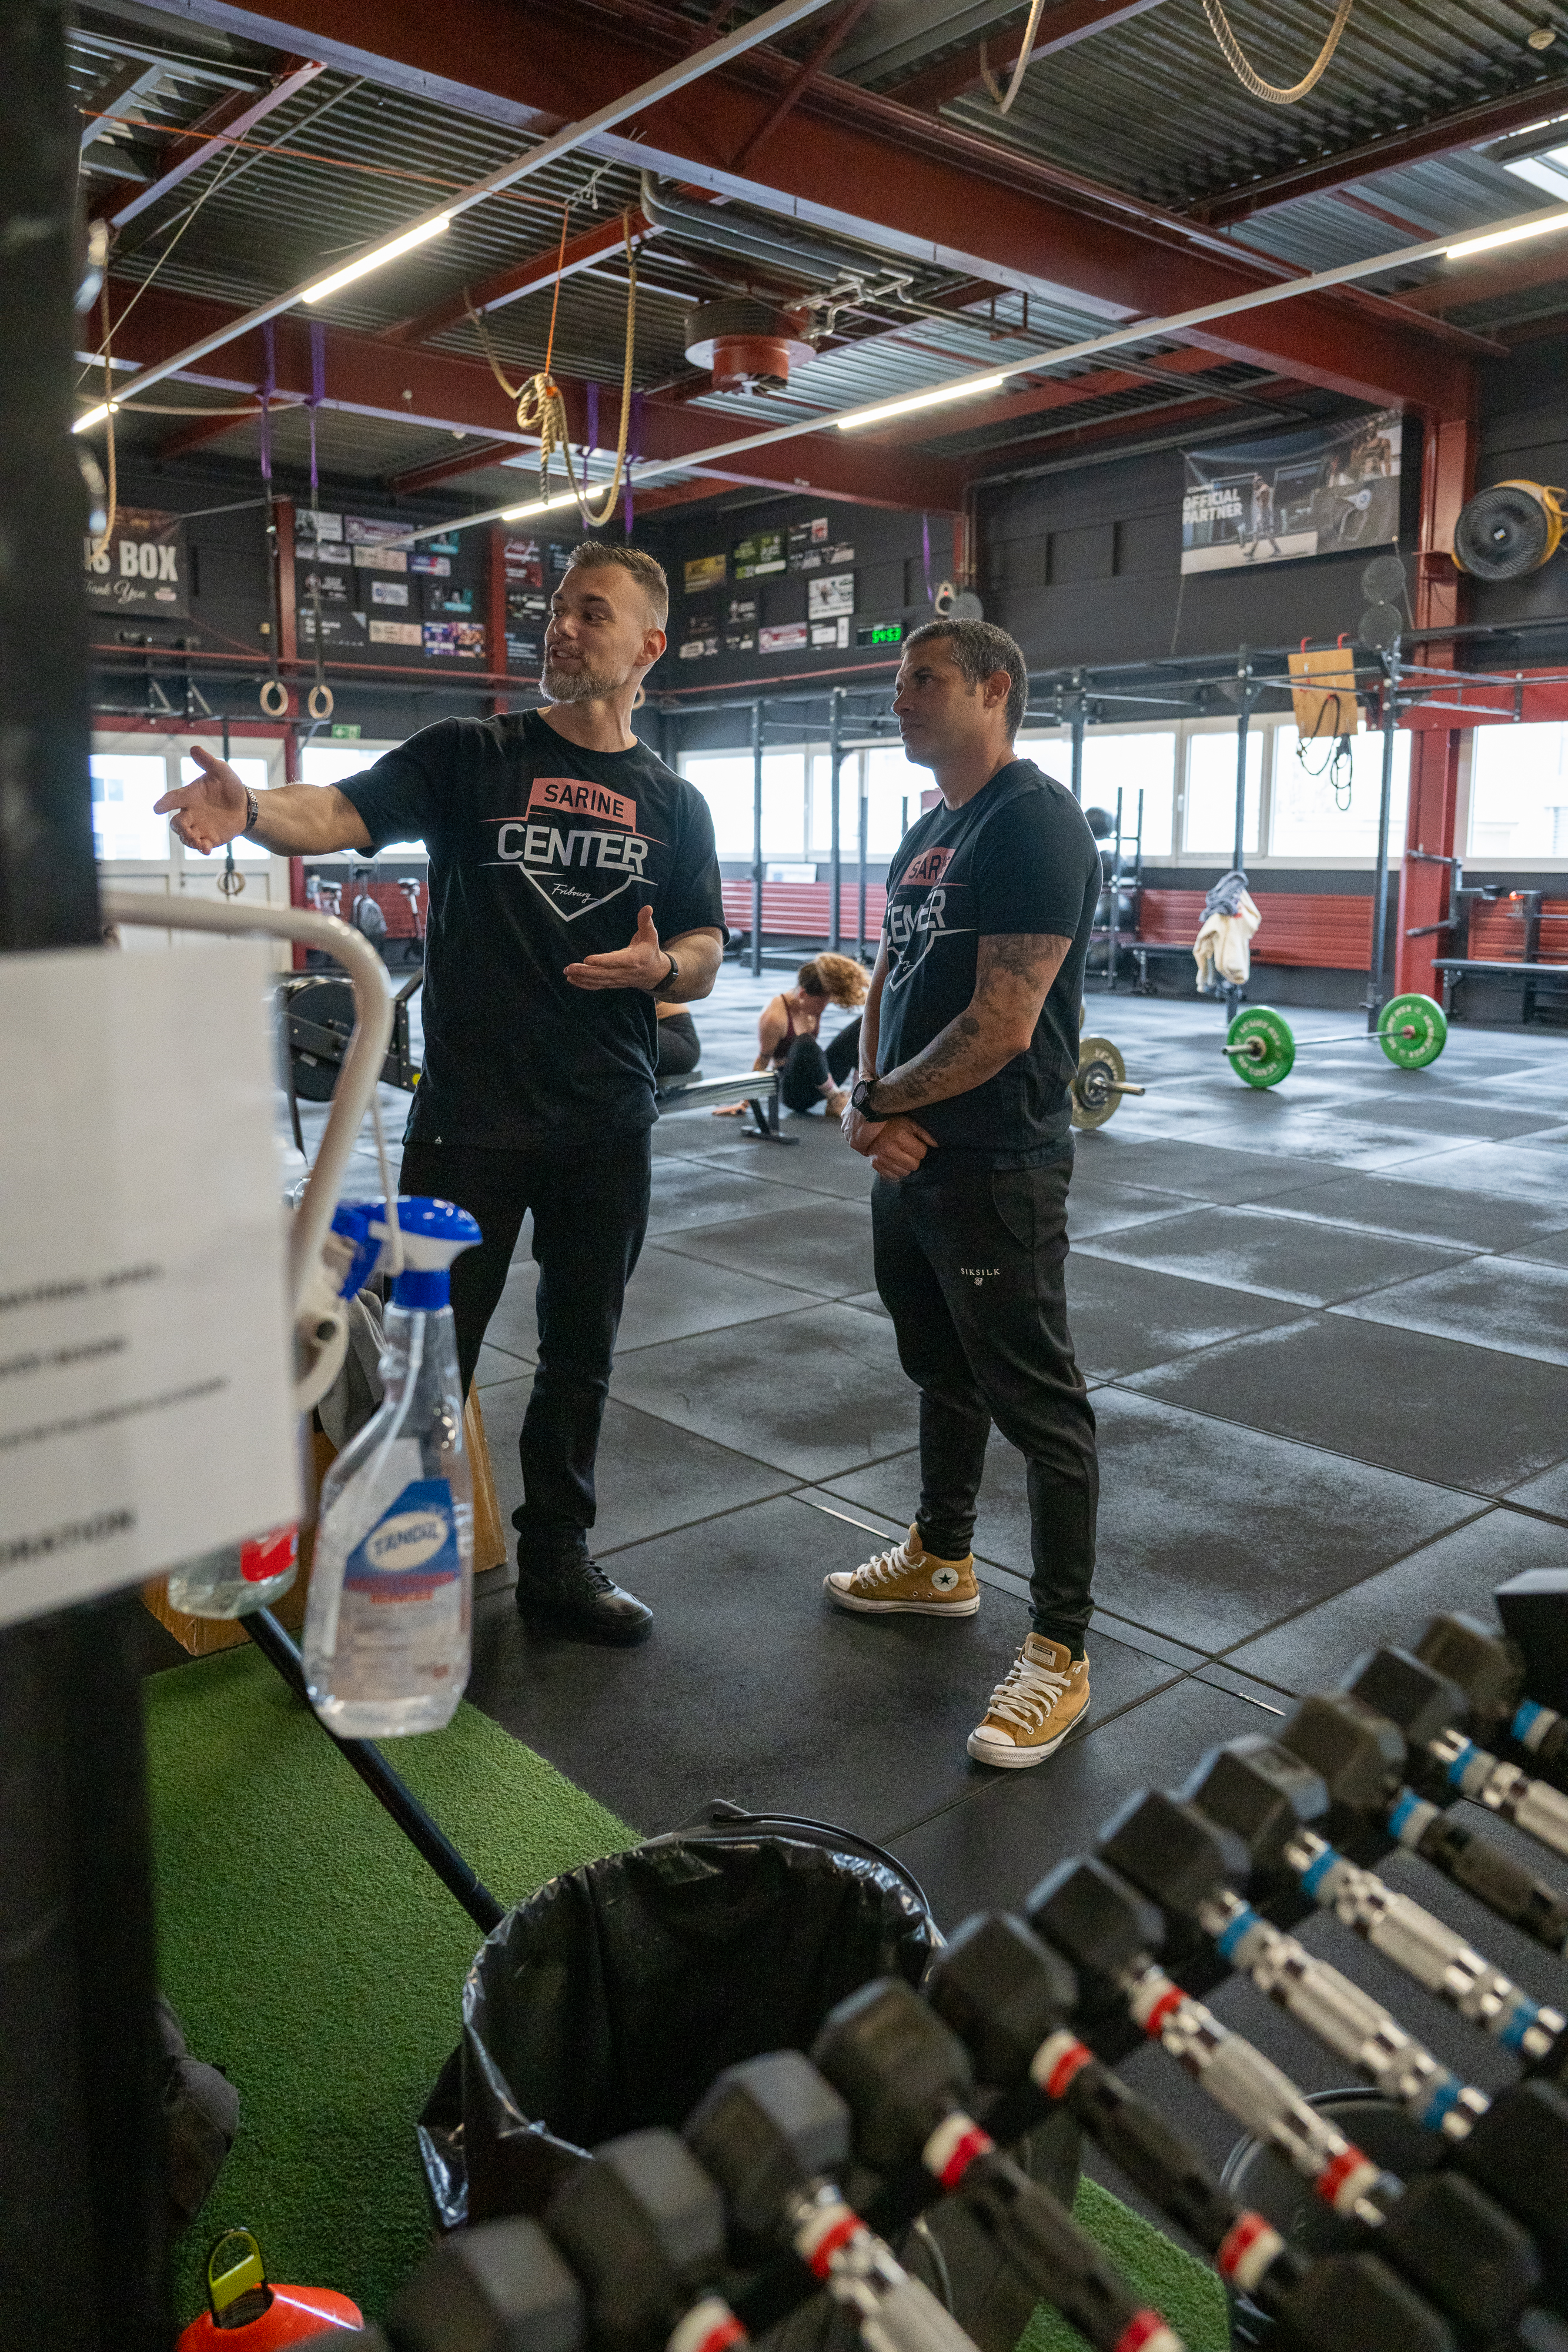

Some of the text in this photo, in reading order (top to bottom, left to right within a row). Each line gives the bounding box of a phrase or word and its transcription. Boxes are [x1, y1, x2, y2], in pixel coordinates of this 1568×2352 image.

[1183, 489, 1241, 510] OFFICIAL
[1182, 502, 1243, 524] PARTNER
[119, 540, 178, 582] BOX
[544, 784, 624, 818] SARINE
[497, 823, 648, 875] CENTER
[551, 883, 598, 903] Fribourg
[961, 1268, 1001, 1276] SIKSILK
